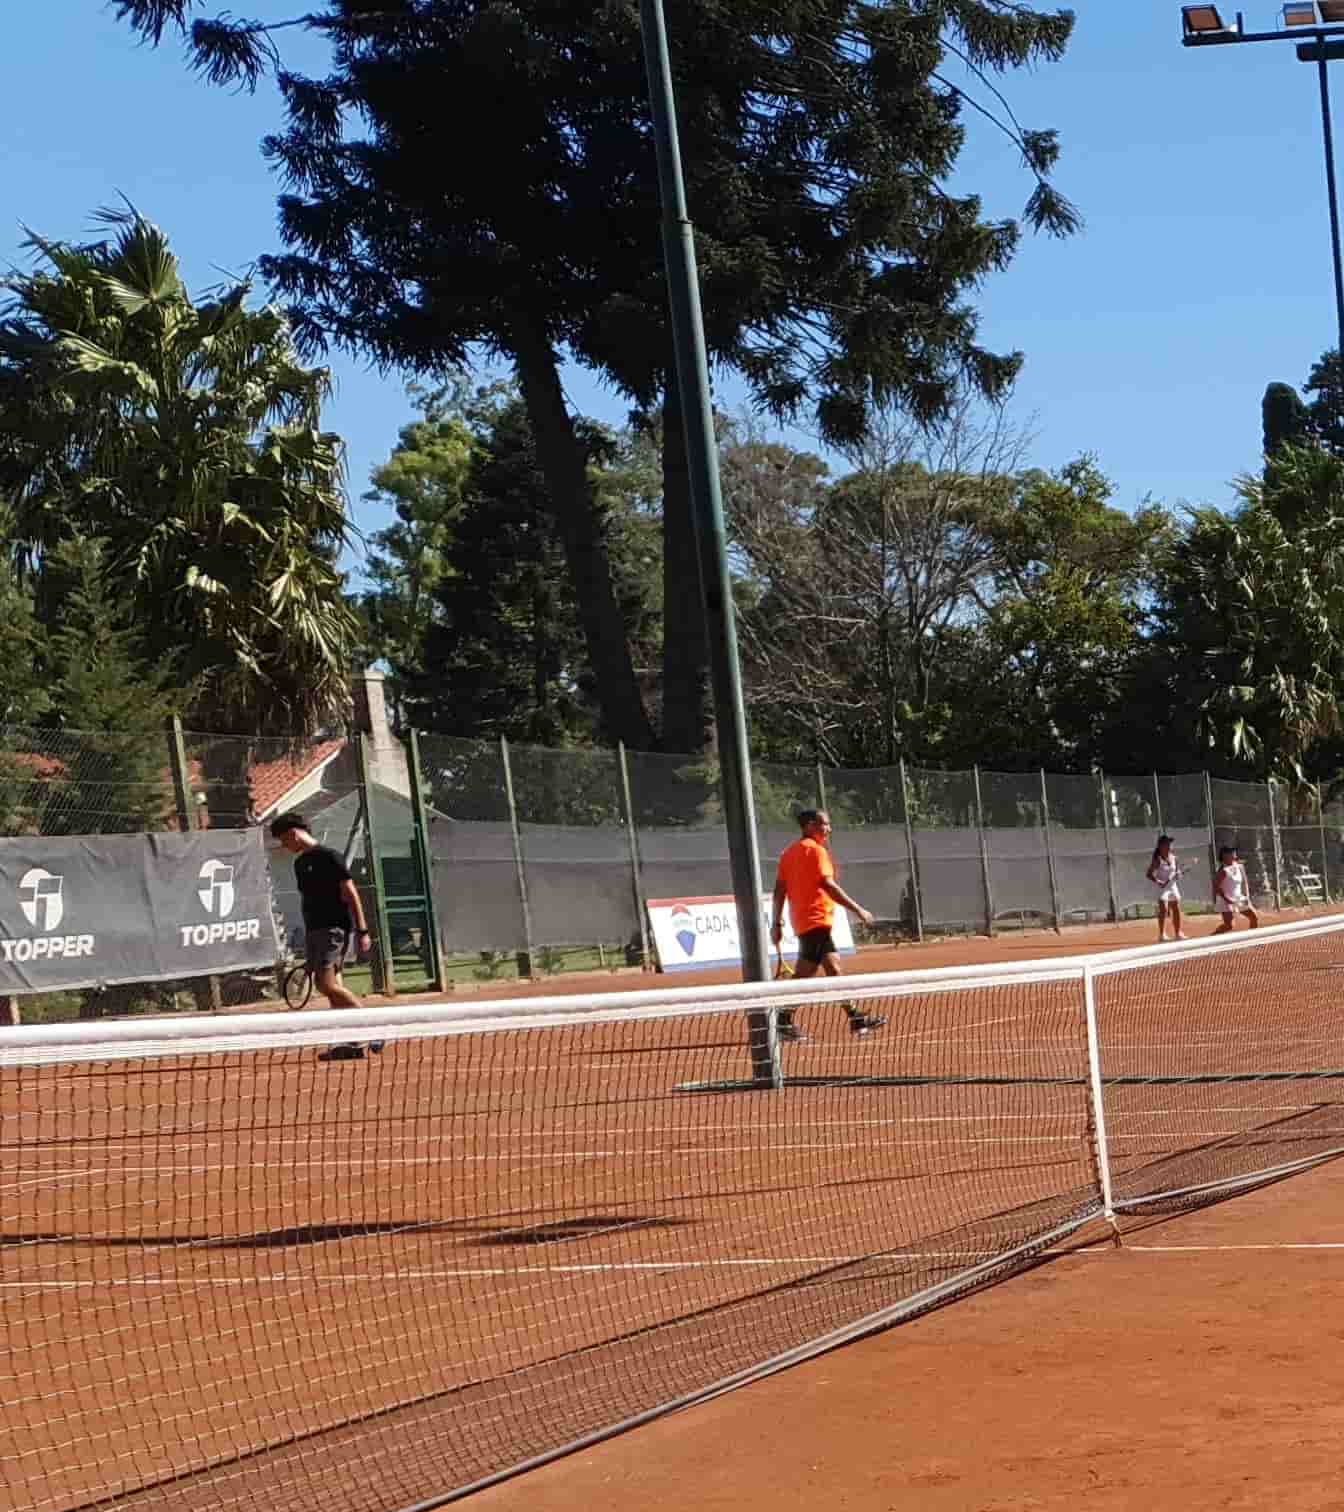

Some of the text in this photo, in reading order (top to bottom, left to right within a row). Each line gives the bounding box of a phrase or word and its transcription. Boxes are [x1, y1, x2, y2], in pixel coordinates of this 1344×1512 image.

[180, 918, 261, 947] TOPPER
[696, 912, 731, 934] CADA
[0, 934, 96, 961] TOPPER
